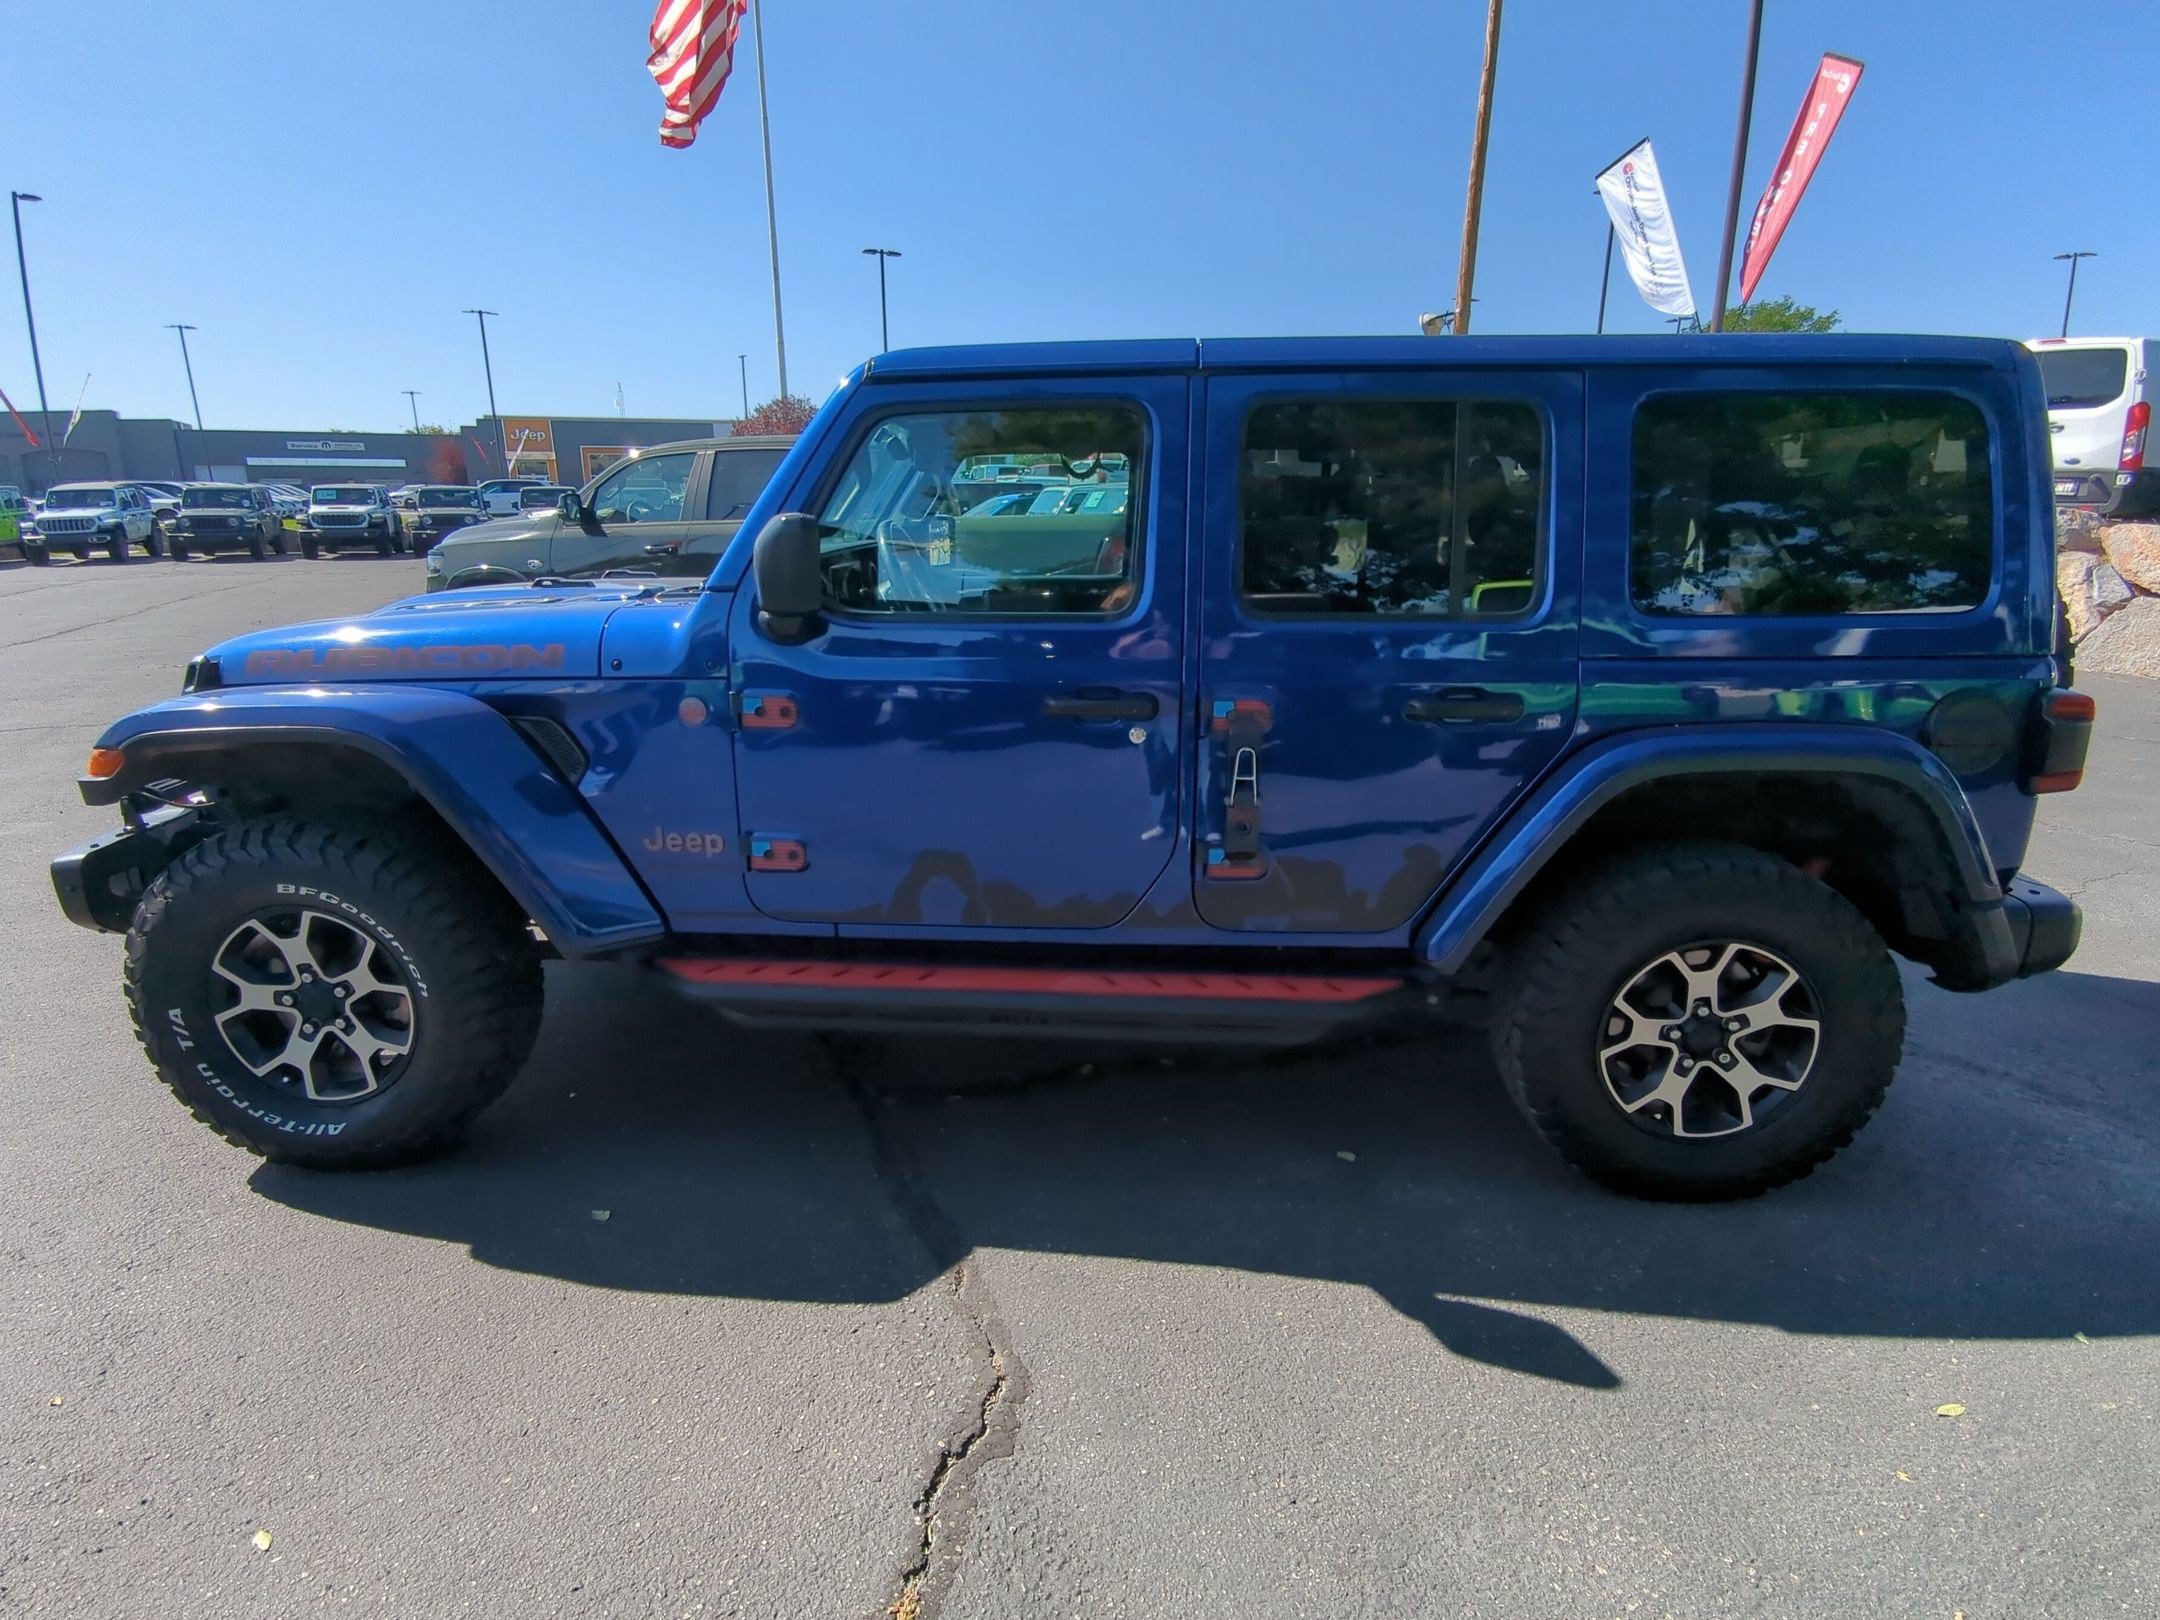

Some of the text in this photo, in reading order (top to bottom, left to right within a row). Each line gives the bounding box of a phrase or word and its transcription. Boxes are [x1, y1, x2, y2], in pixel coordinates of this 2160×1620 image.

[510, 429, 546, 442] Jeep
[246, 644, 564, 673] RUBICON
[643, 825, 724, 857] Jeep
[277, 883, 428, 998] BFGoodrich
[168, 1008, 347, 1136] All-Terrain T/A
